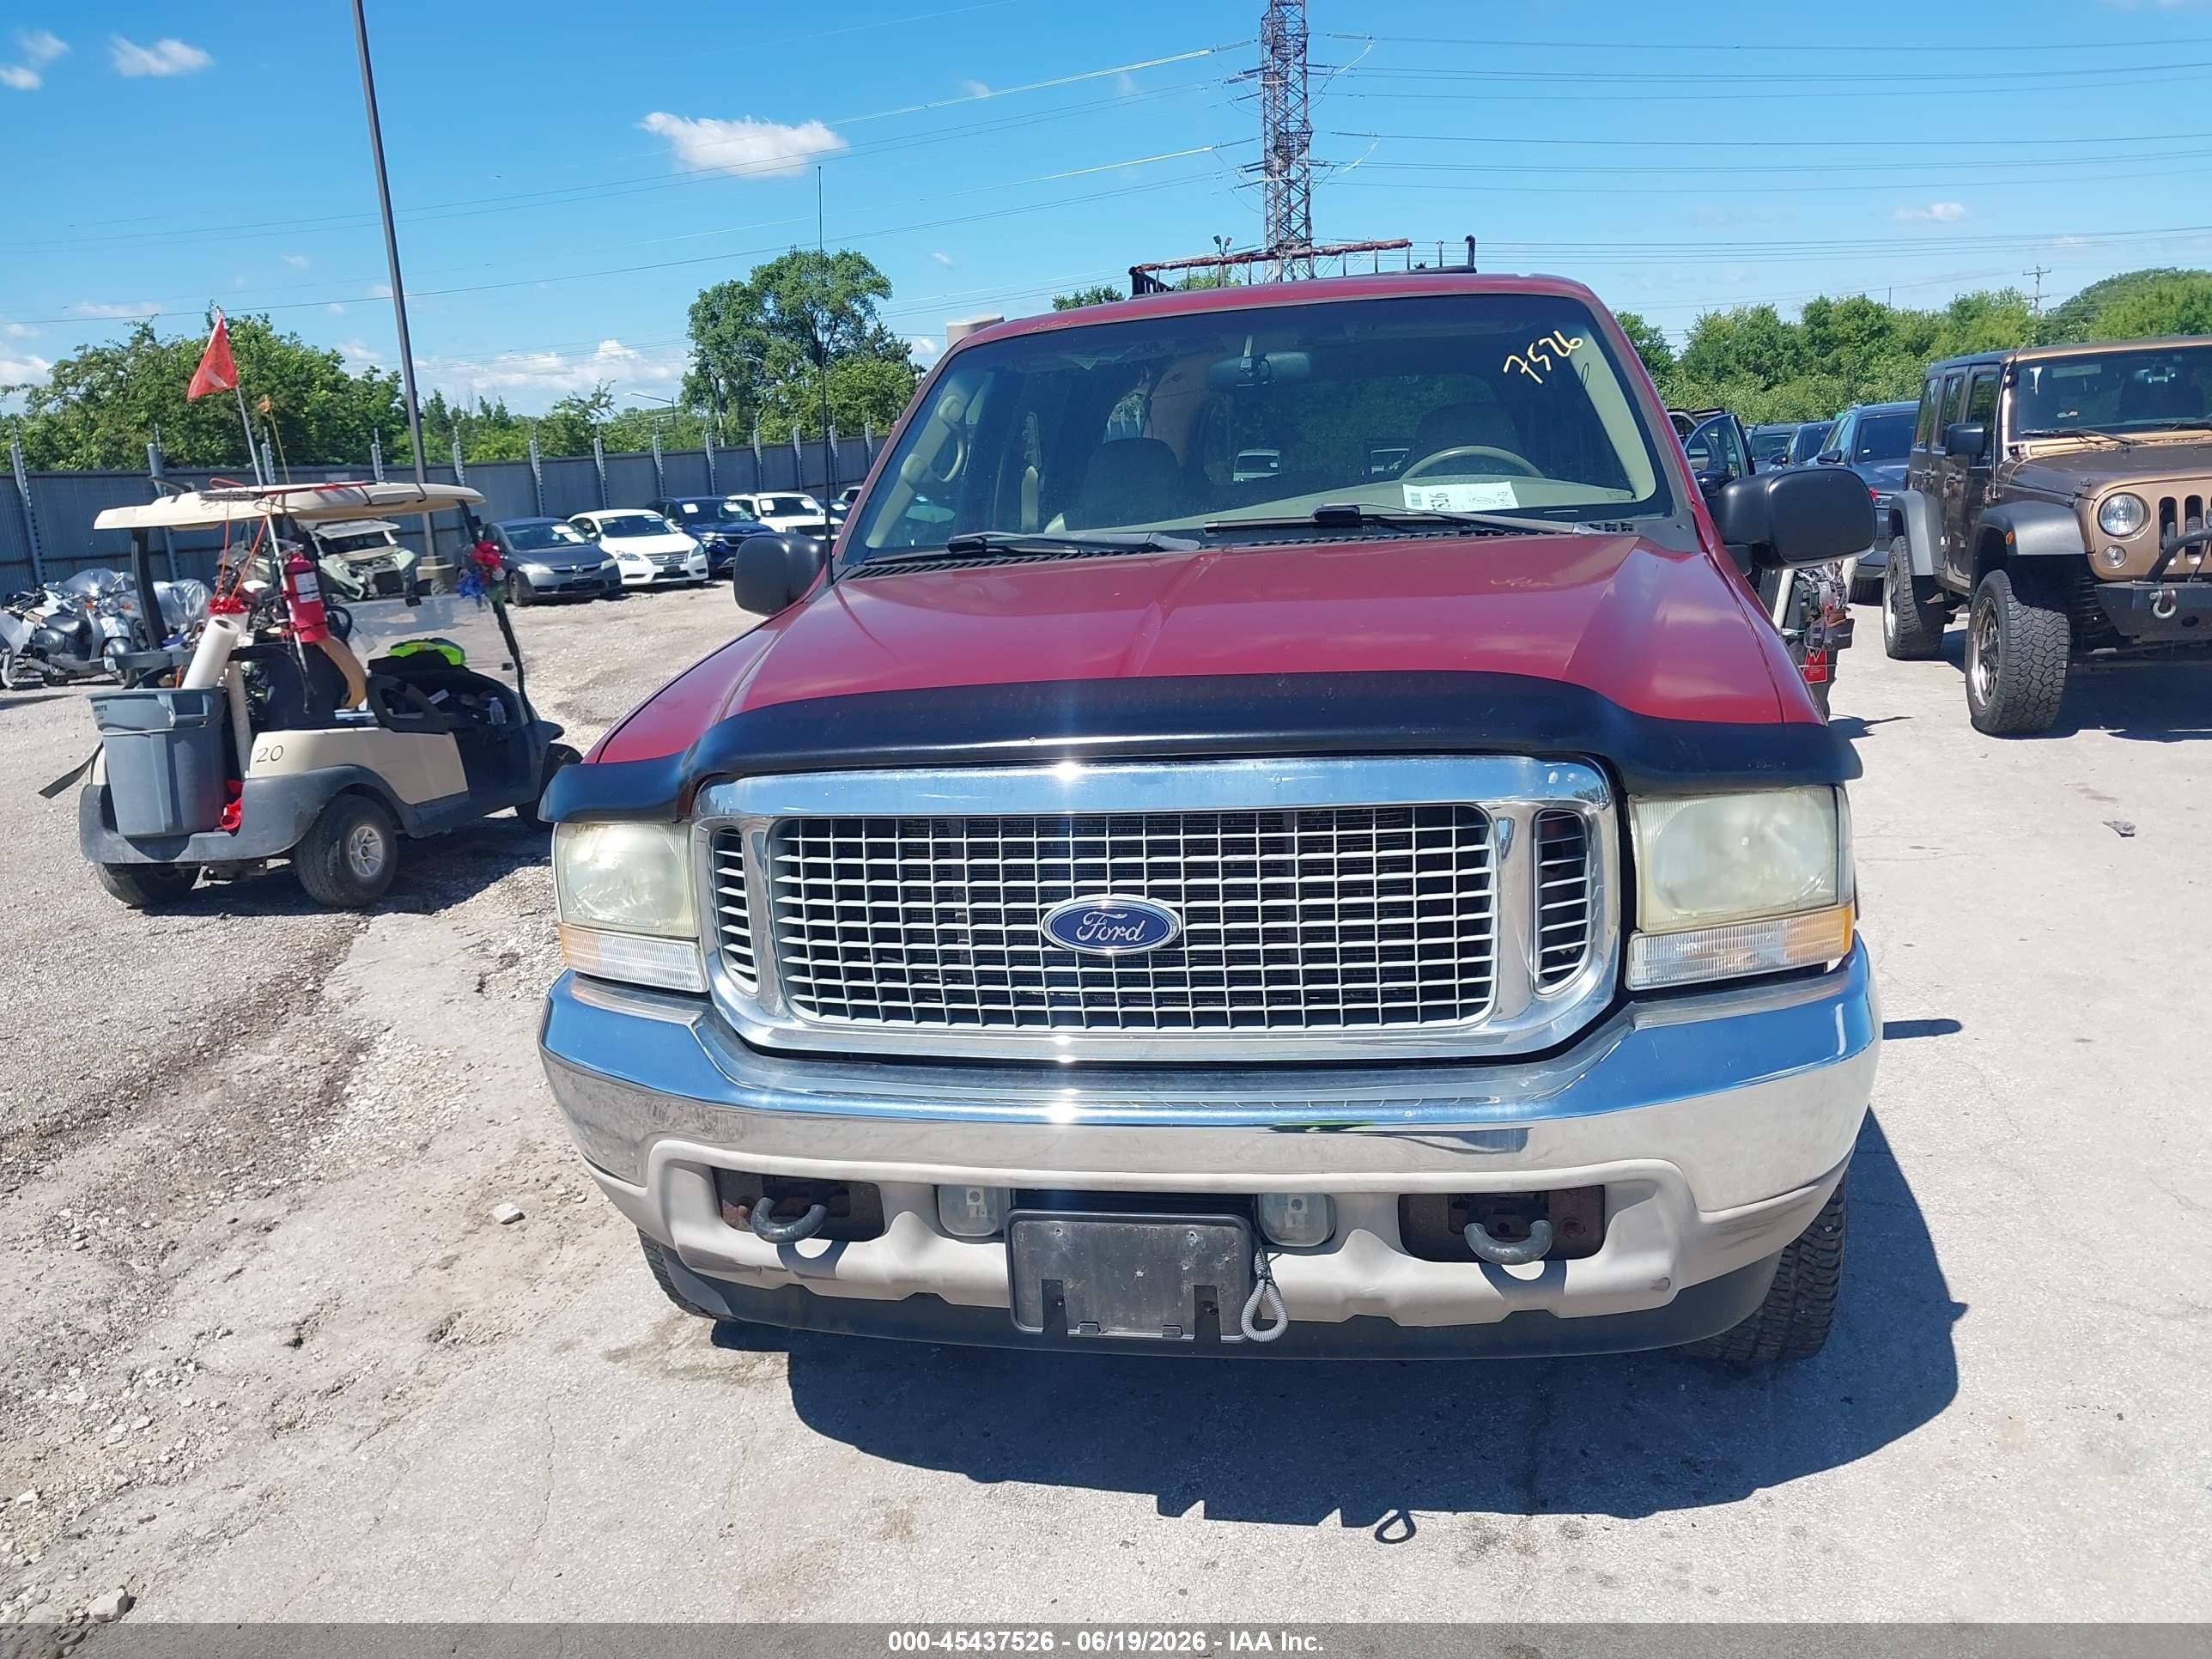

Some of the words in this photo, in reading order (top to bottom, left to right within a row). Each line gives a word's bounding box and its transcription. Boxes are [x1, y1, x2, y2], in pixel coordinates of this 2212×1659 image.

[1503, 330, 1583, 384] 7526
[256, 745, 284, 763] 20
[1076, 911, 1146, 942] Ford
